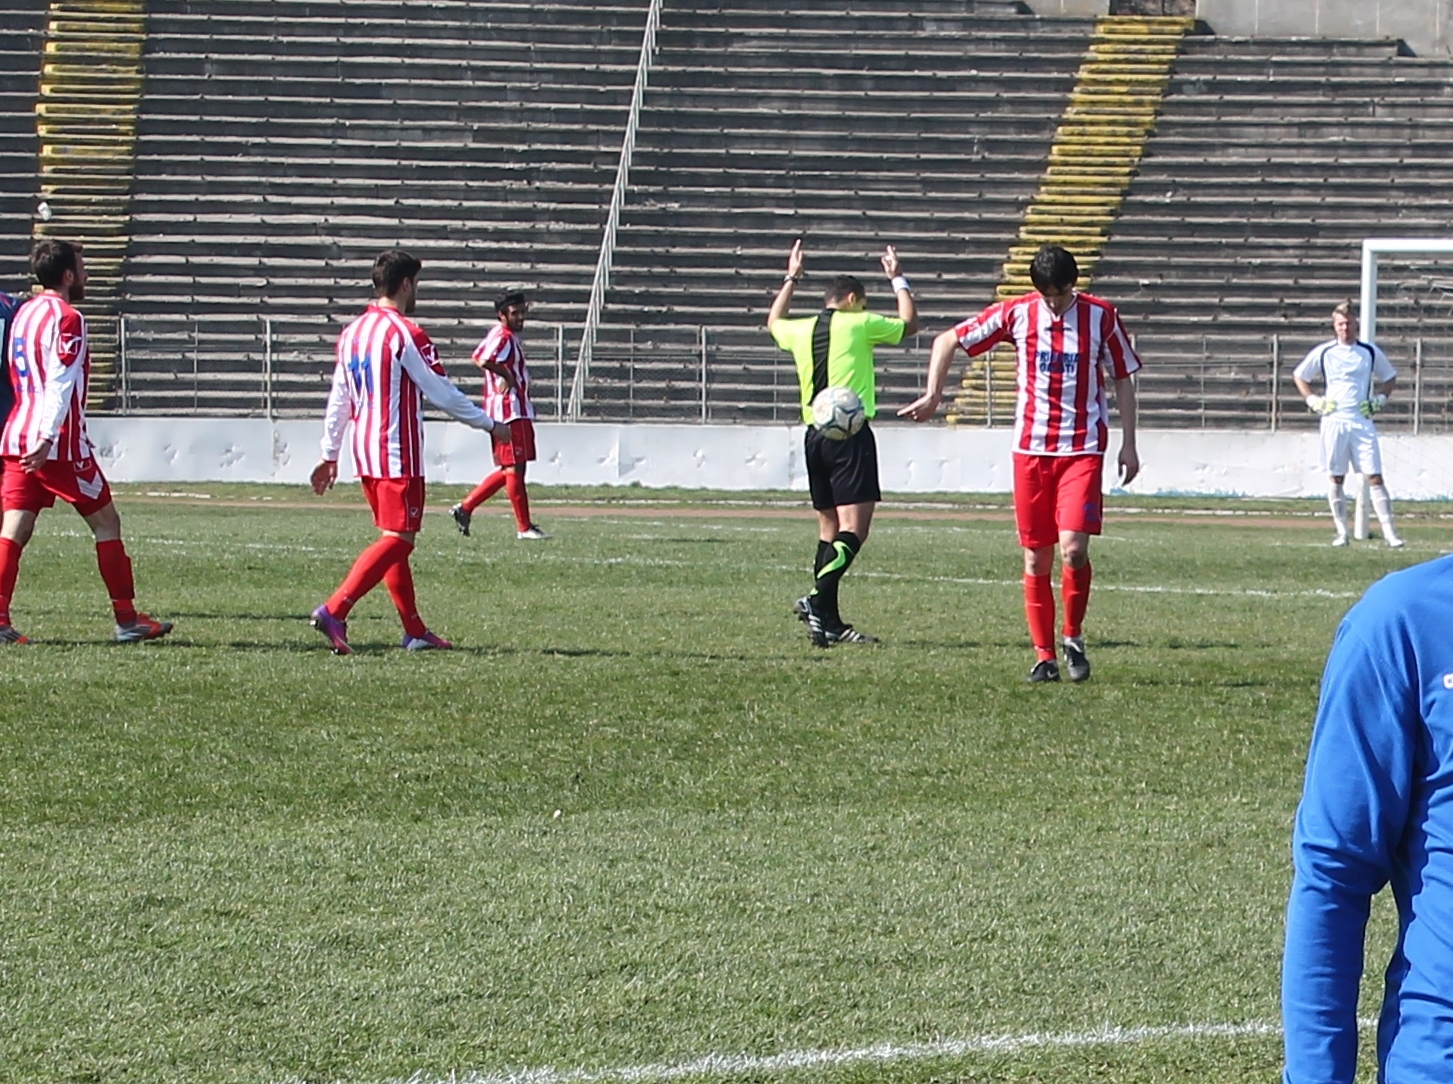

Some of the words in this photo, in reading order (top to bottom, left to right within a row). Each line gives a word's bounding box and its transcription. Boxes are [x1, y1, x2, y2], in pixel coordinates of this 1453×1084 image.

[13, 336, 30, 377] 5
[347, 352, 374, 395] 11
[1039, 363, 1075, 374] GAATI
